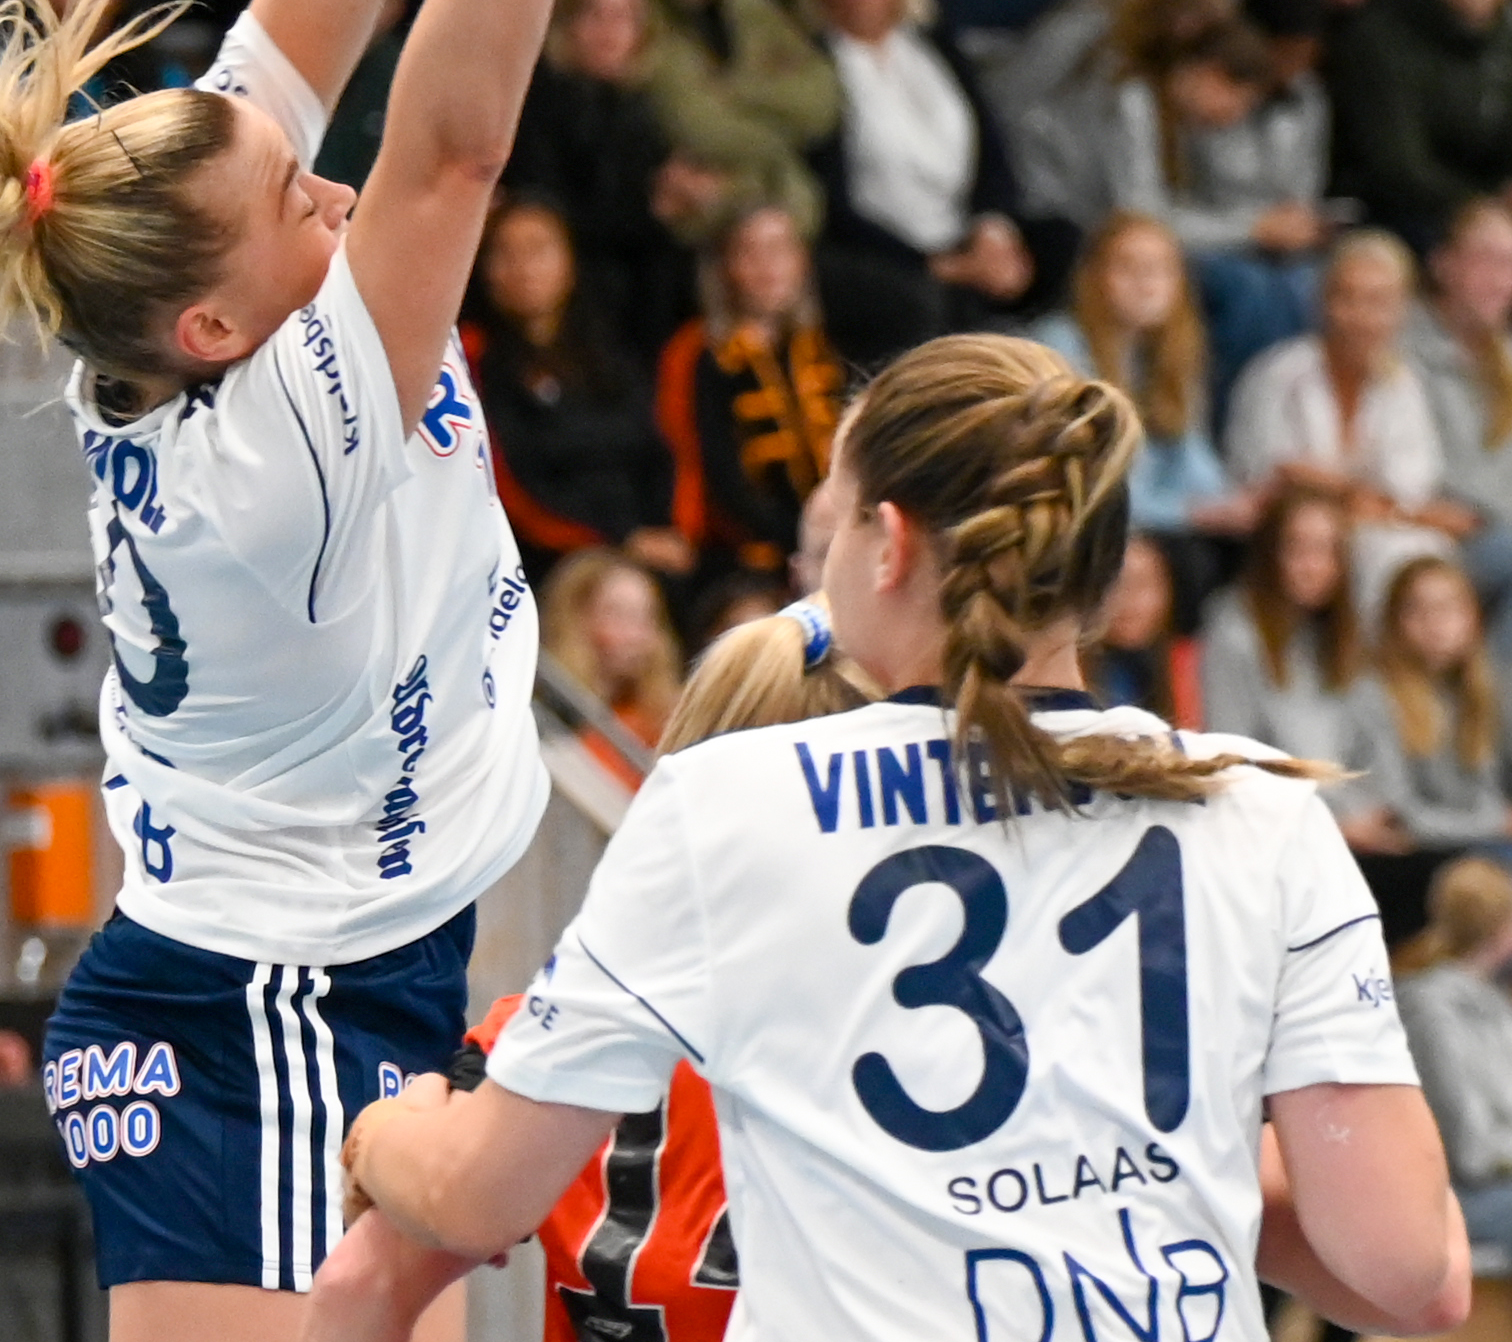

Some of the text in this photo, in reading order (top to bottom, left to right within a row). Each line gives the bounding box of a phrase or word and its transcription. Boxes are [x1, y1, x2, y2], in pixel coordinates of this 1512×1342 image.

[847, 824, 1191, 1153] 31
[43, 1041, 181, 1115] REMA
[57, 1100, 160, 1169] 000
[947, 1143, 1181, 1215] SOLAAS
